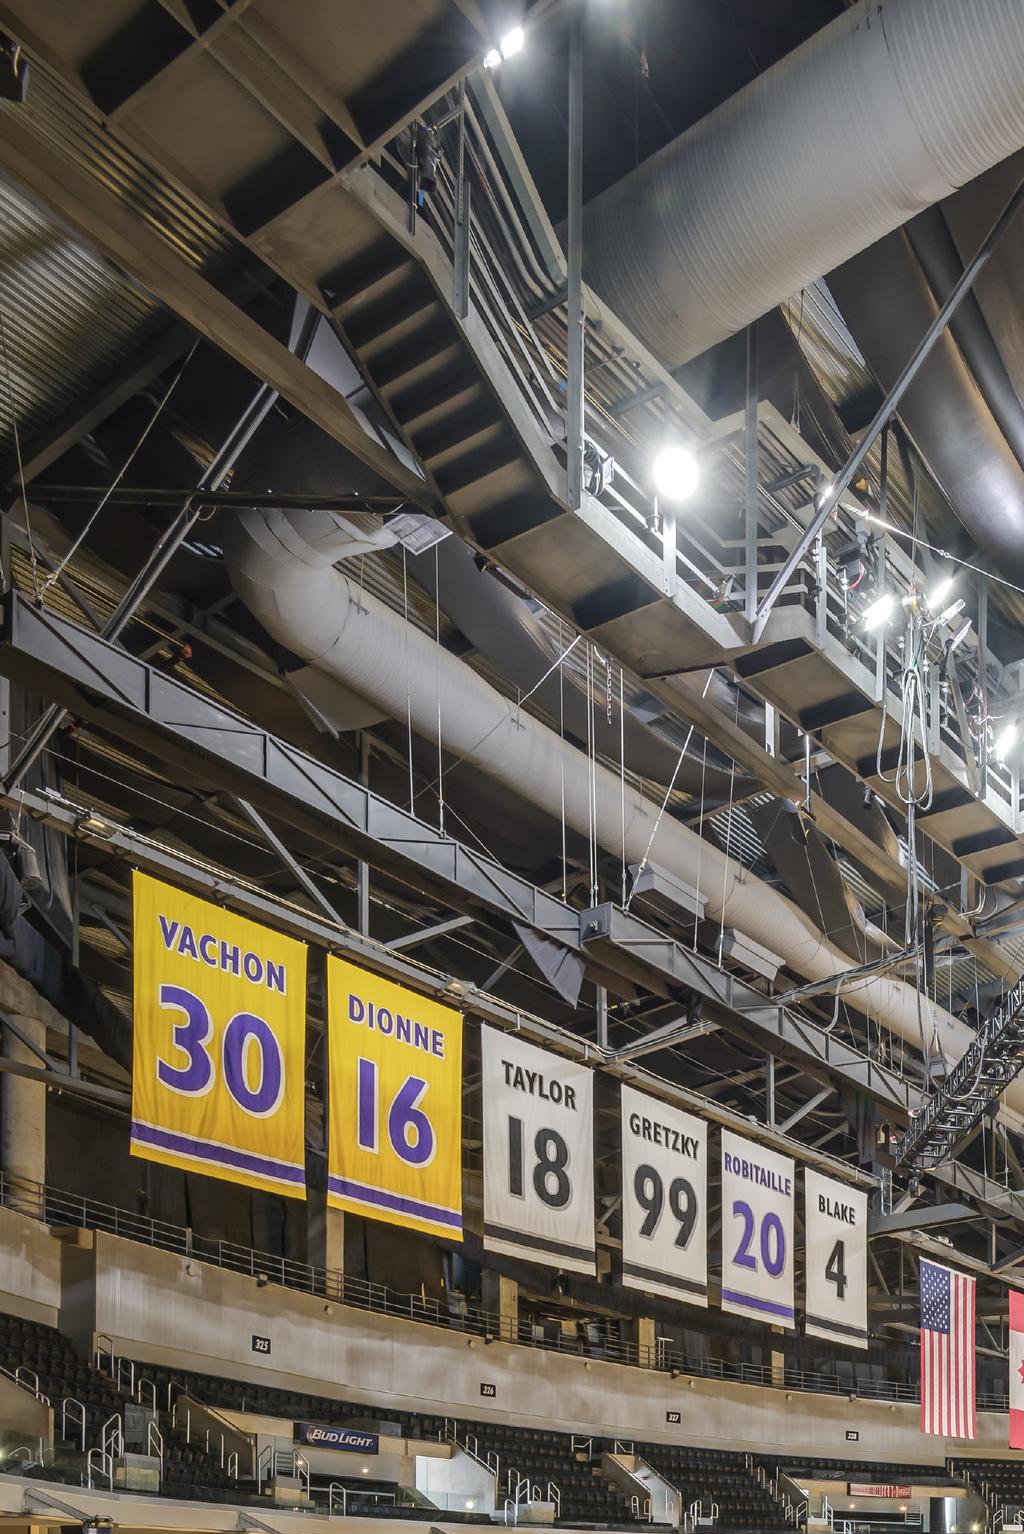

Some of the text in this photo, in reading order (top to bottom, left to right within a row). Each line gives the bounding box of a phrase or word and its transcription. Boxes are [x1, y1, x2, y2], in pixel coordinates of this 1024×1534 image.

[158, 914, 287, 996] VACHON
[156, 983, 286, 1119] 30
[348, 992, 446, 1061] DIONNE
[356, 1056, 437, 1169] 16
[501, 1059, 578, 1111] TAYLOR
[507, 1114, 573, 1212] 18
[629, 1113, 700, 1161] GRETZKY
[724, 1151, 792, 1198] ROBITAILLE
[633, 1164, 698, 1251] 99
[818, 1194, 856, 1226] BLAKE
[731, 1200, 787, 1280] 20
[825, 1239, 847, 1300] 4
[255, 1338, 268, 1351] 325
[483, 1385, 494, 1395] 326
[669, 1414, 679, 1422] 327
[311, 1429, 373, 1447] BUD LIGHT
